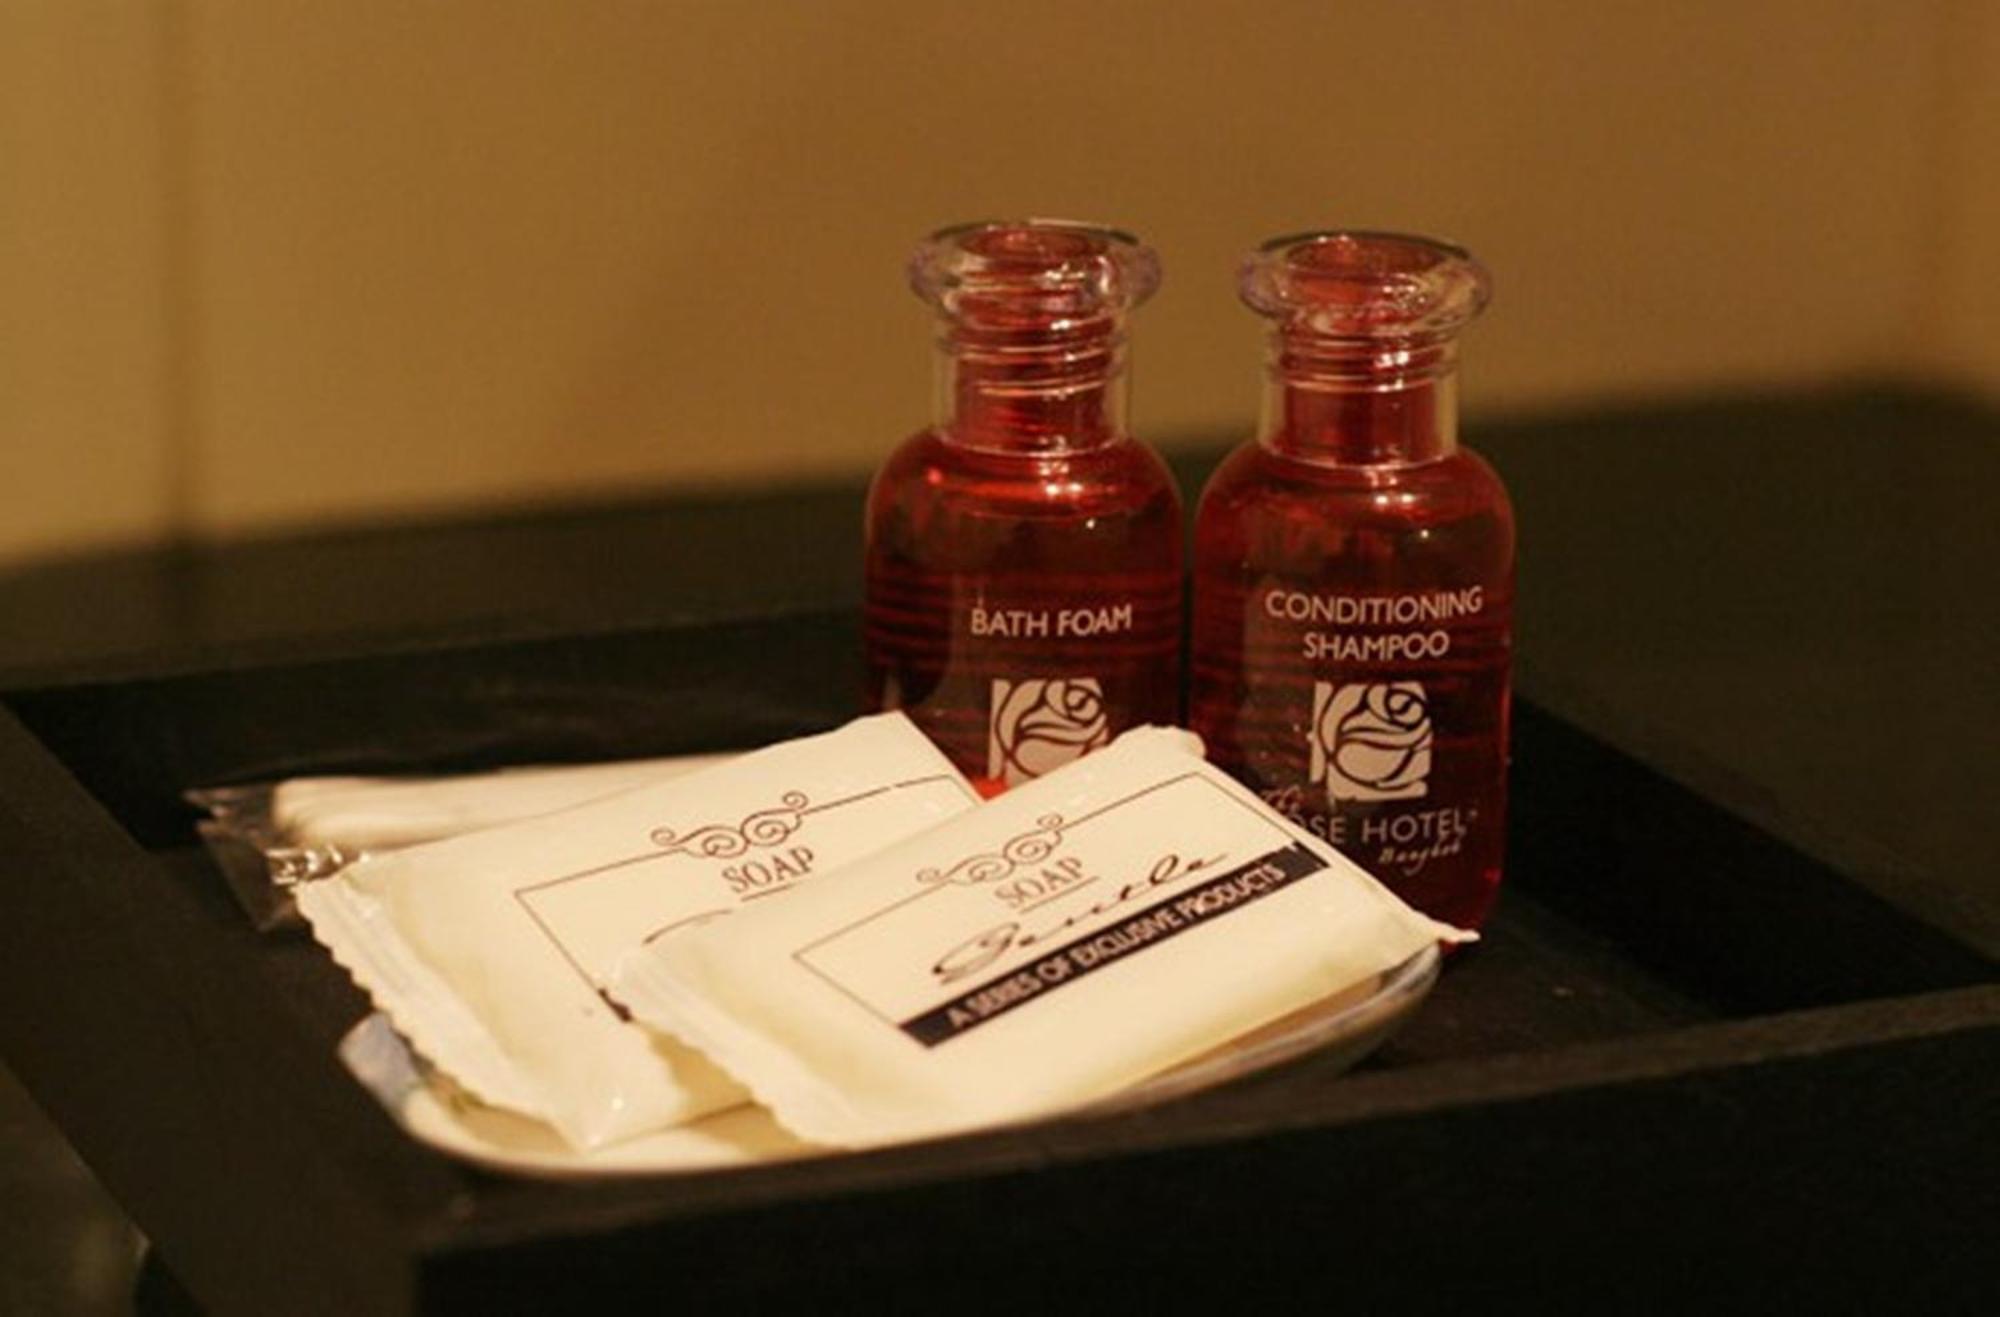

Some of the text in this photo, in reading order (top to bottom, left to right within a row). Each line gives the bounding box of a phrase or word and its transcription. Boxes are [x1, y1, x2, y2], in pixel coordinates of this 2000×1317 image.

[970, 603, 1133, 637] BATH FOAM
[1264, 584, 1484, 624] CONDITIONING
[1302, 630, 1450, 660] SHAMPOO
[1360, 808, 1467, 843] HOTEL
[721, 846, 815, 894] SOAP
[994, 857, 1083, 909] SOAP
[947, 1005, 974, 1028] A
[1035, 953, 1075, 984] OF
[1067, 907, 1184, 967] EXCLUSIVE
[1173, 863, 1287, 919] PRODUCTS
